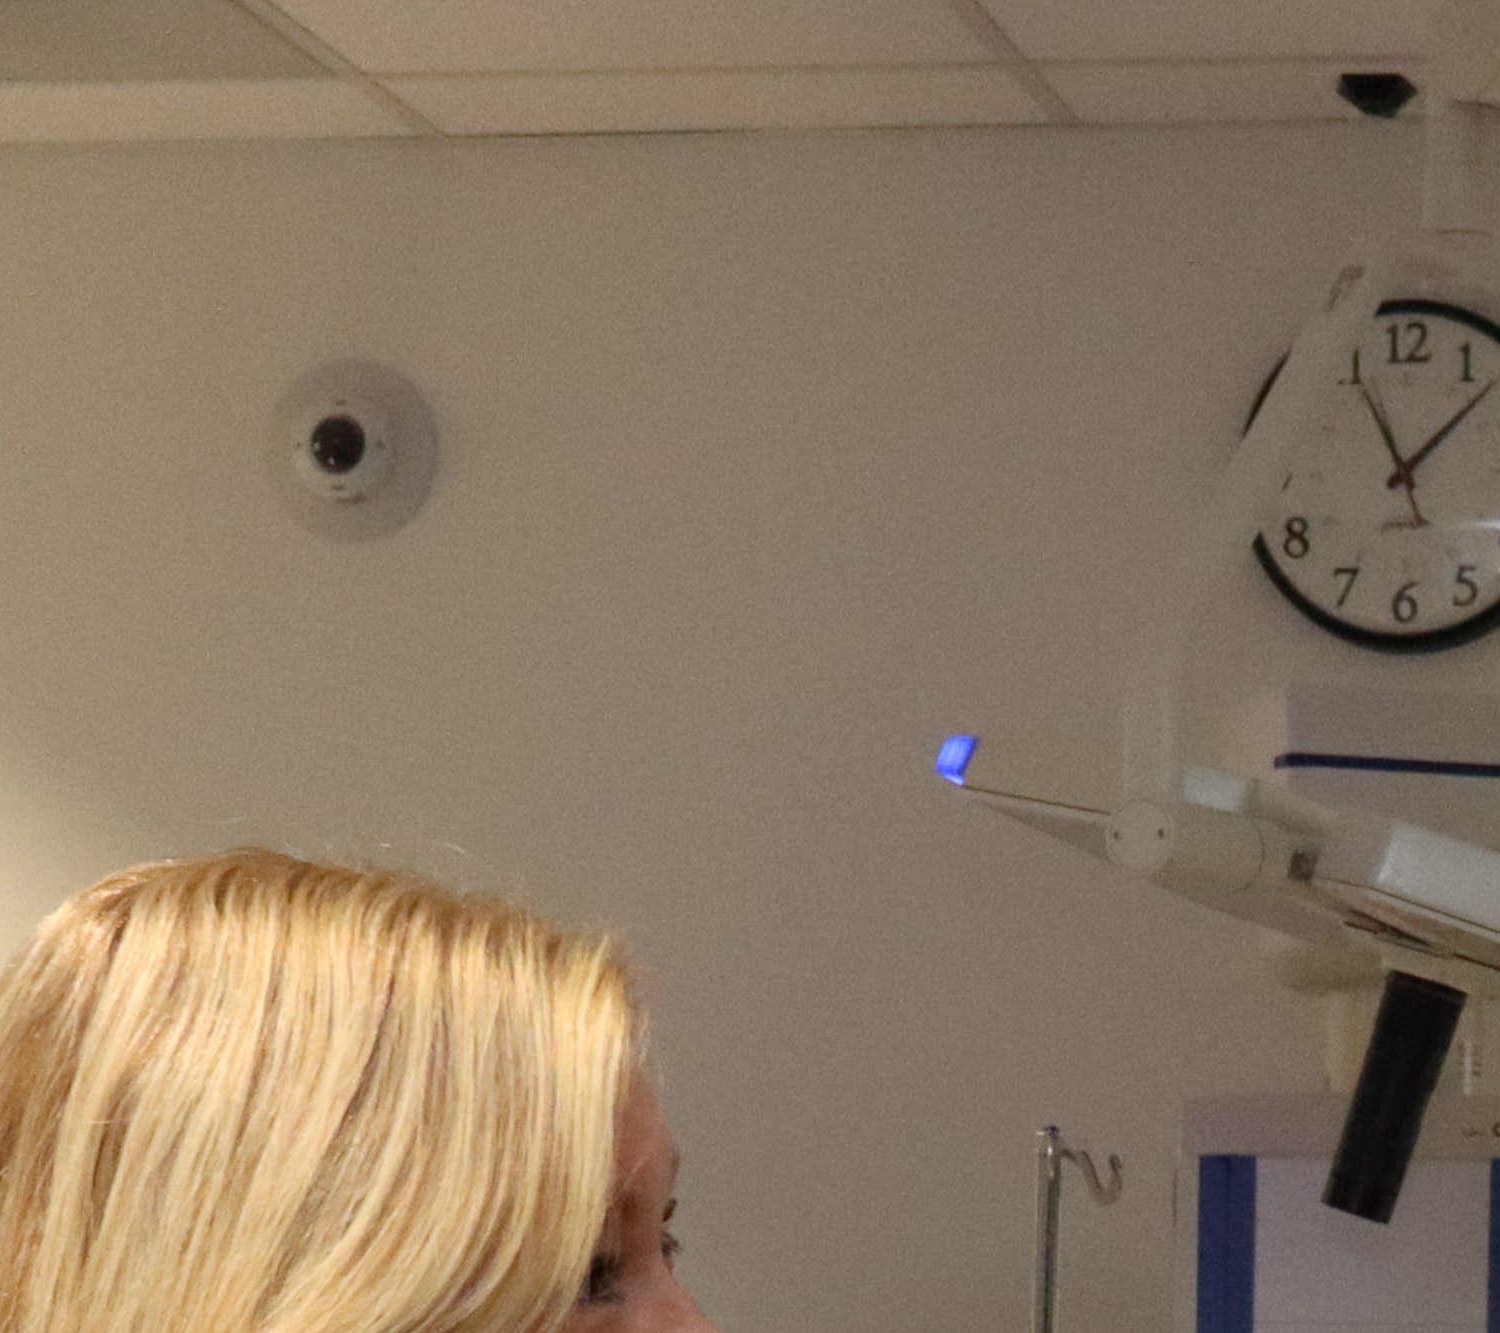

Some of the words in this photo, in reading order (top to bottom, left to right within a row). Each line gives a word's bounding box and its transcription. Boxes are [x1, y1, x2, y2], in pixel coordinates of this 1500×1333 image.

[1386, 322, 1431, 364] 12
[1459, 342, 1475, 383] 1
[1282, 516, 1311, 559] 8
[1333, 567, 1360, 609] 7
[1391, 581, 1419, 624] 6
[1453, 565, 1478, 607] 5
